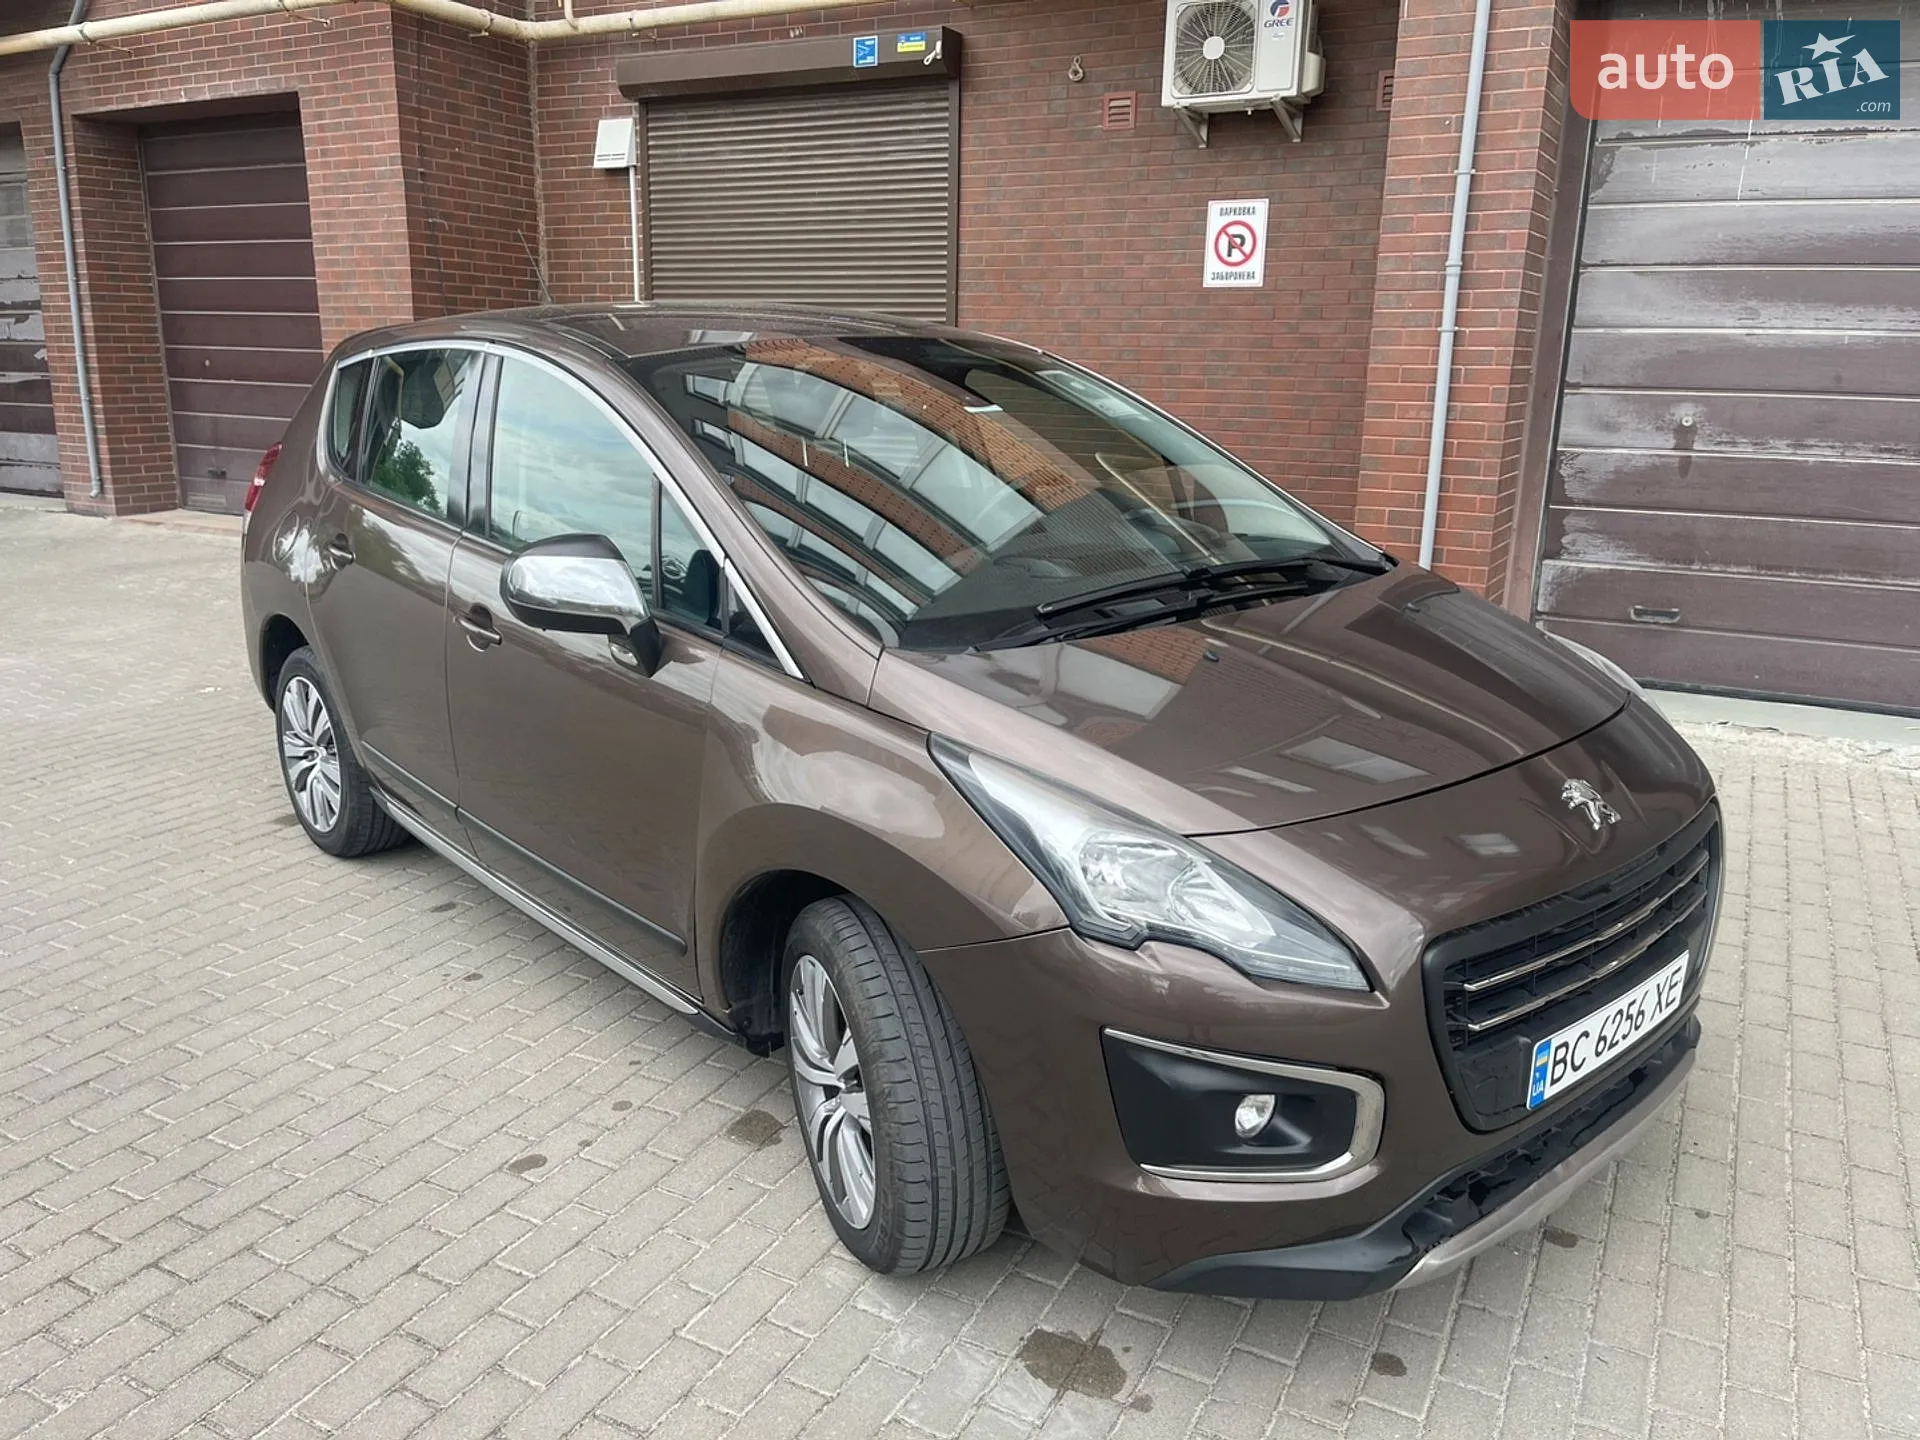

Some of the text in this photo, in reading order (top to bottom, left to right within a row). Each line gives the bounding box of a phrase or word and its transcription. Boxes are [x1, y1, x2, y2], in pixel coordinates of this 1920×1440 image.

[1264, 18, 1294, 28] GREE
[1219, 206, 1256, 216] ПАРКОВКА
[1211, 271, 1256, 281] ЗАБОРОНЕНА
[1550, 966, 1683, 1088] BC 6256 XE
